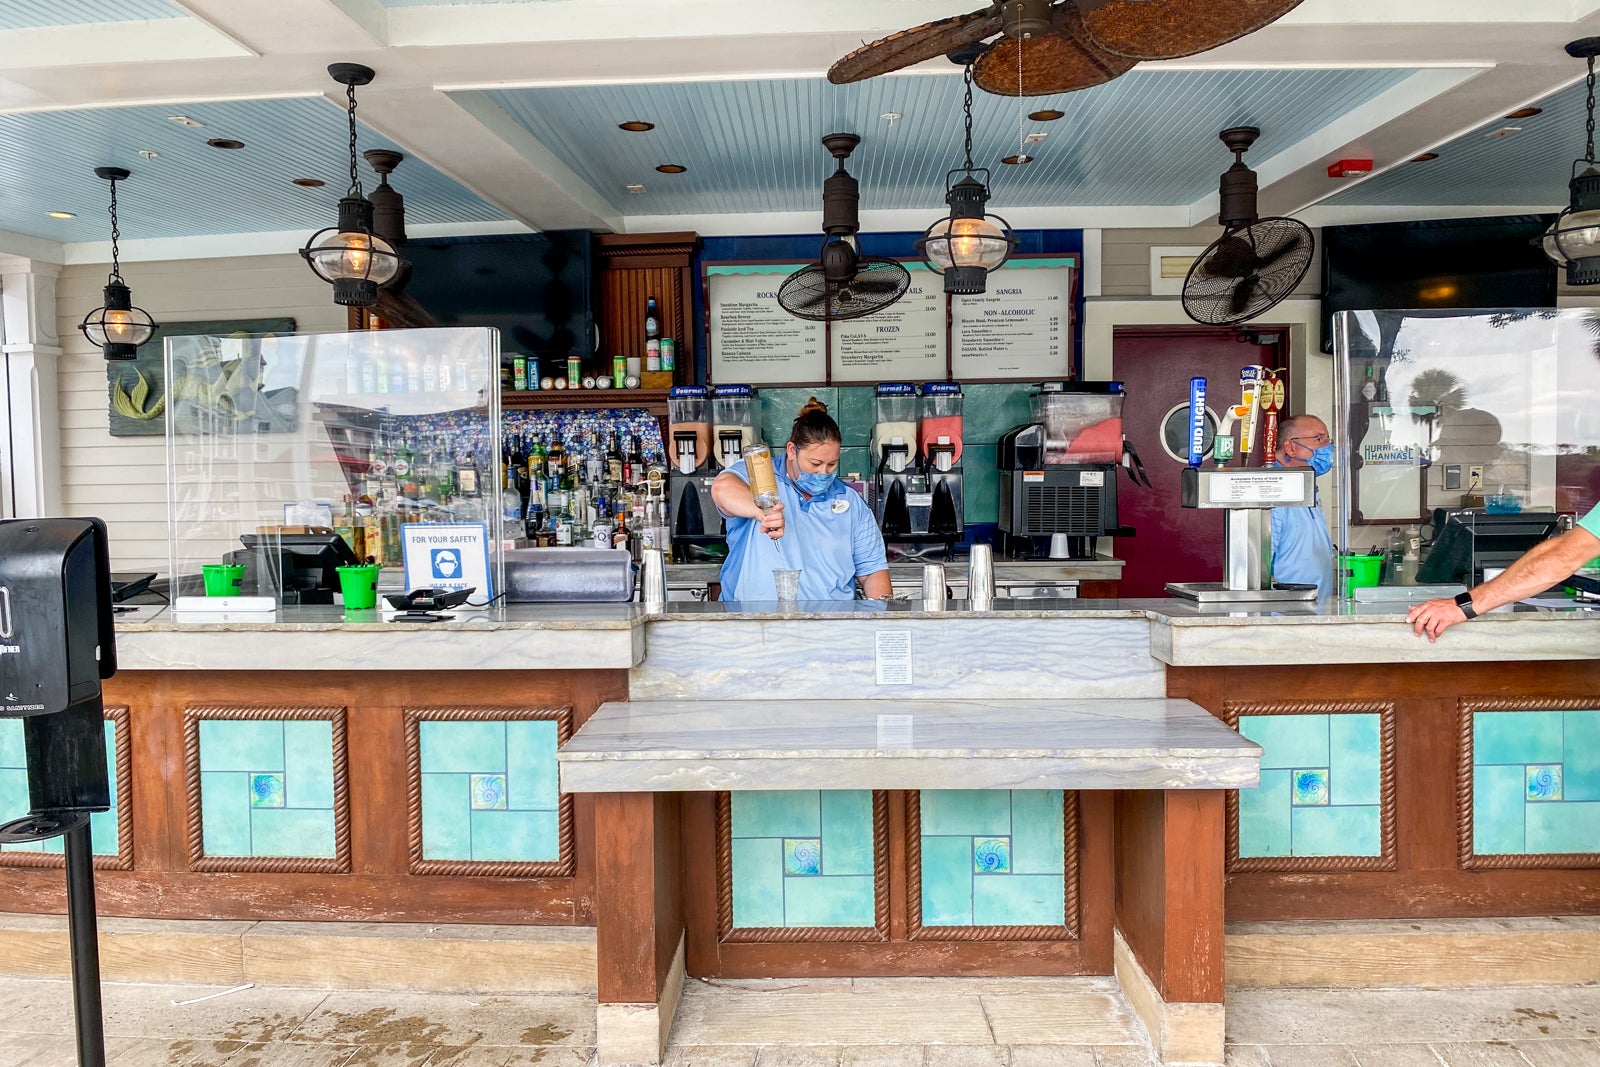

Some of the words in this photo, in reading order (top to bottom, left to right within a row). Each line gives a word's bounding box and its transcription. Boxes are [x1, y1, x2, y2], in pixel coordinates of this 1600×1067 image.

[1194, 390, 1205, 427] LIGHT
[1193, 427, 1203, 454] BUD
[428, 535, 447, 543] YOUR
[450, 535, 477, 543] SAFETY
